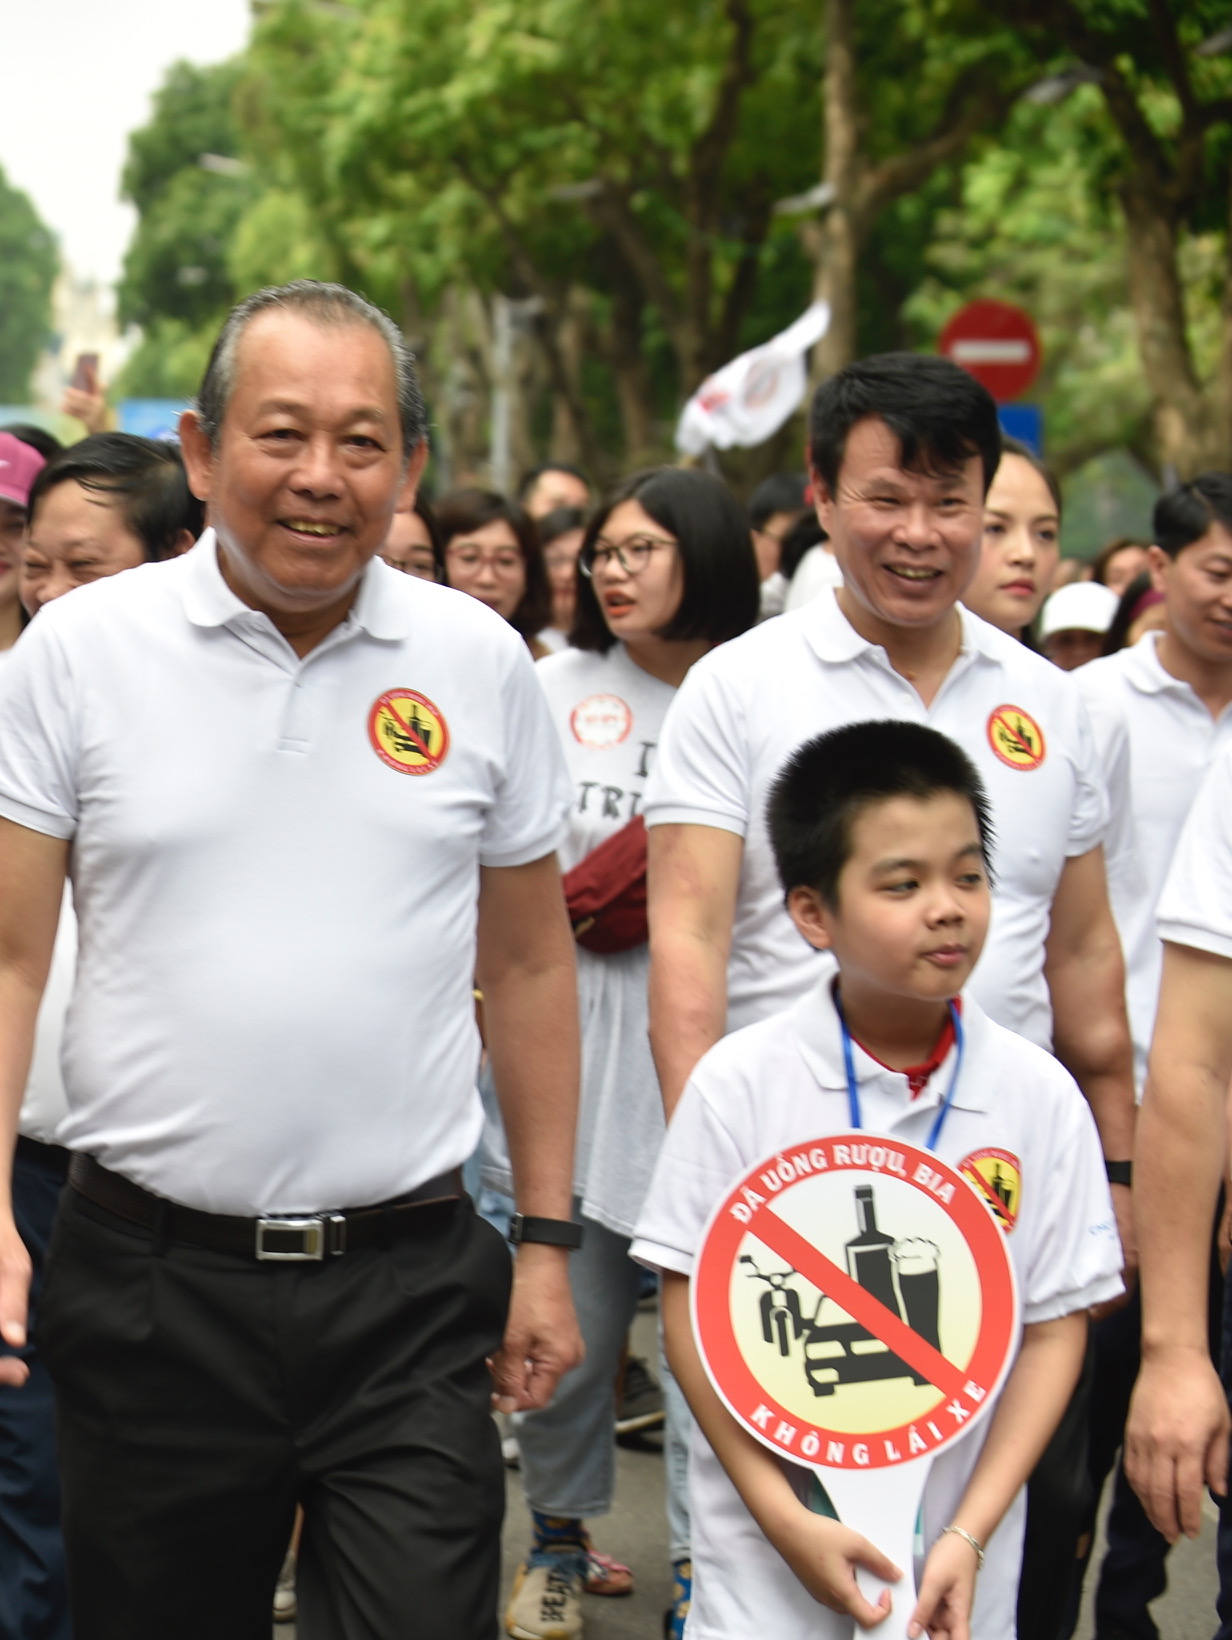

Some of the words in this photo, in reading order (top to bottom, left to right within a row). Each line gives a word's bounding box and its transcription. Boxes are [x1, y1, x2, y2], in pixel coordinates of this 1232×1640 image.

[728, 1184, 767, 1225] ĐÃ
[759, 1152, 828, 1193] UỐNG
[912, 1161, 957, 1205] BIA
[749, 1402, 870, 1466] KHÔNG
[883, 1420, 944, 1462] LÁI
[945, 1379, 987, 1425] XE
